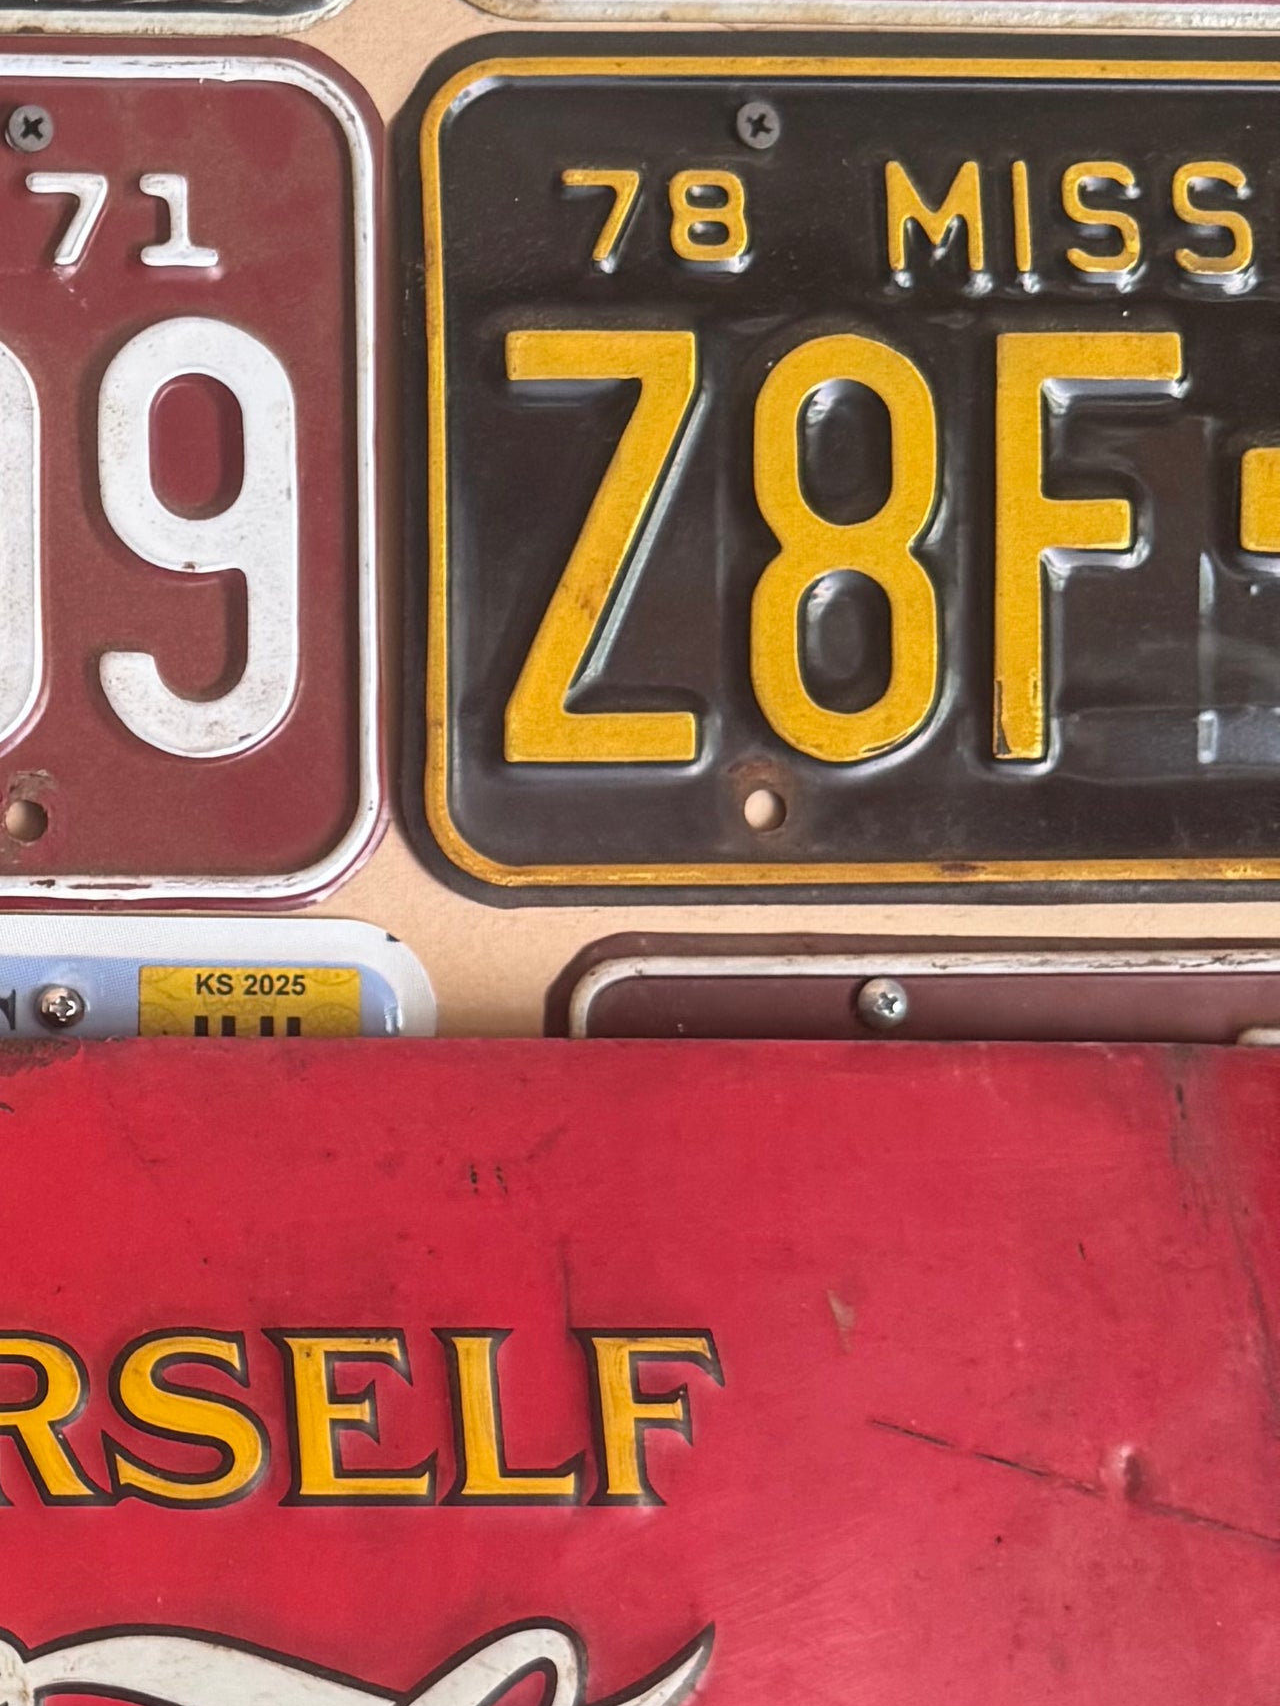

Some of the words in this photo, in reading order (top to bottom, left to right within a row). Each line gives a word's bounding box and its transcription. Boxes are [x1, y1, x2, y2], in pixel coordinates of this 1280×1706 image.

[26, 172, 219, 269] 71
[561, 169, 747, 263] 78
[885, 160, 1254, 274] MISS
[195, 973, 234, 996] KS
[243, 974, 307, 996] 2025
